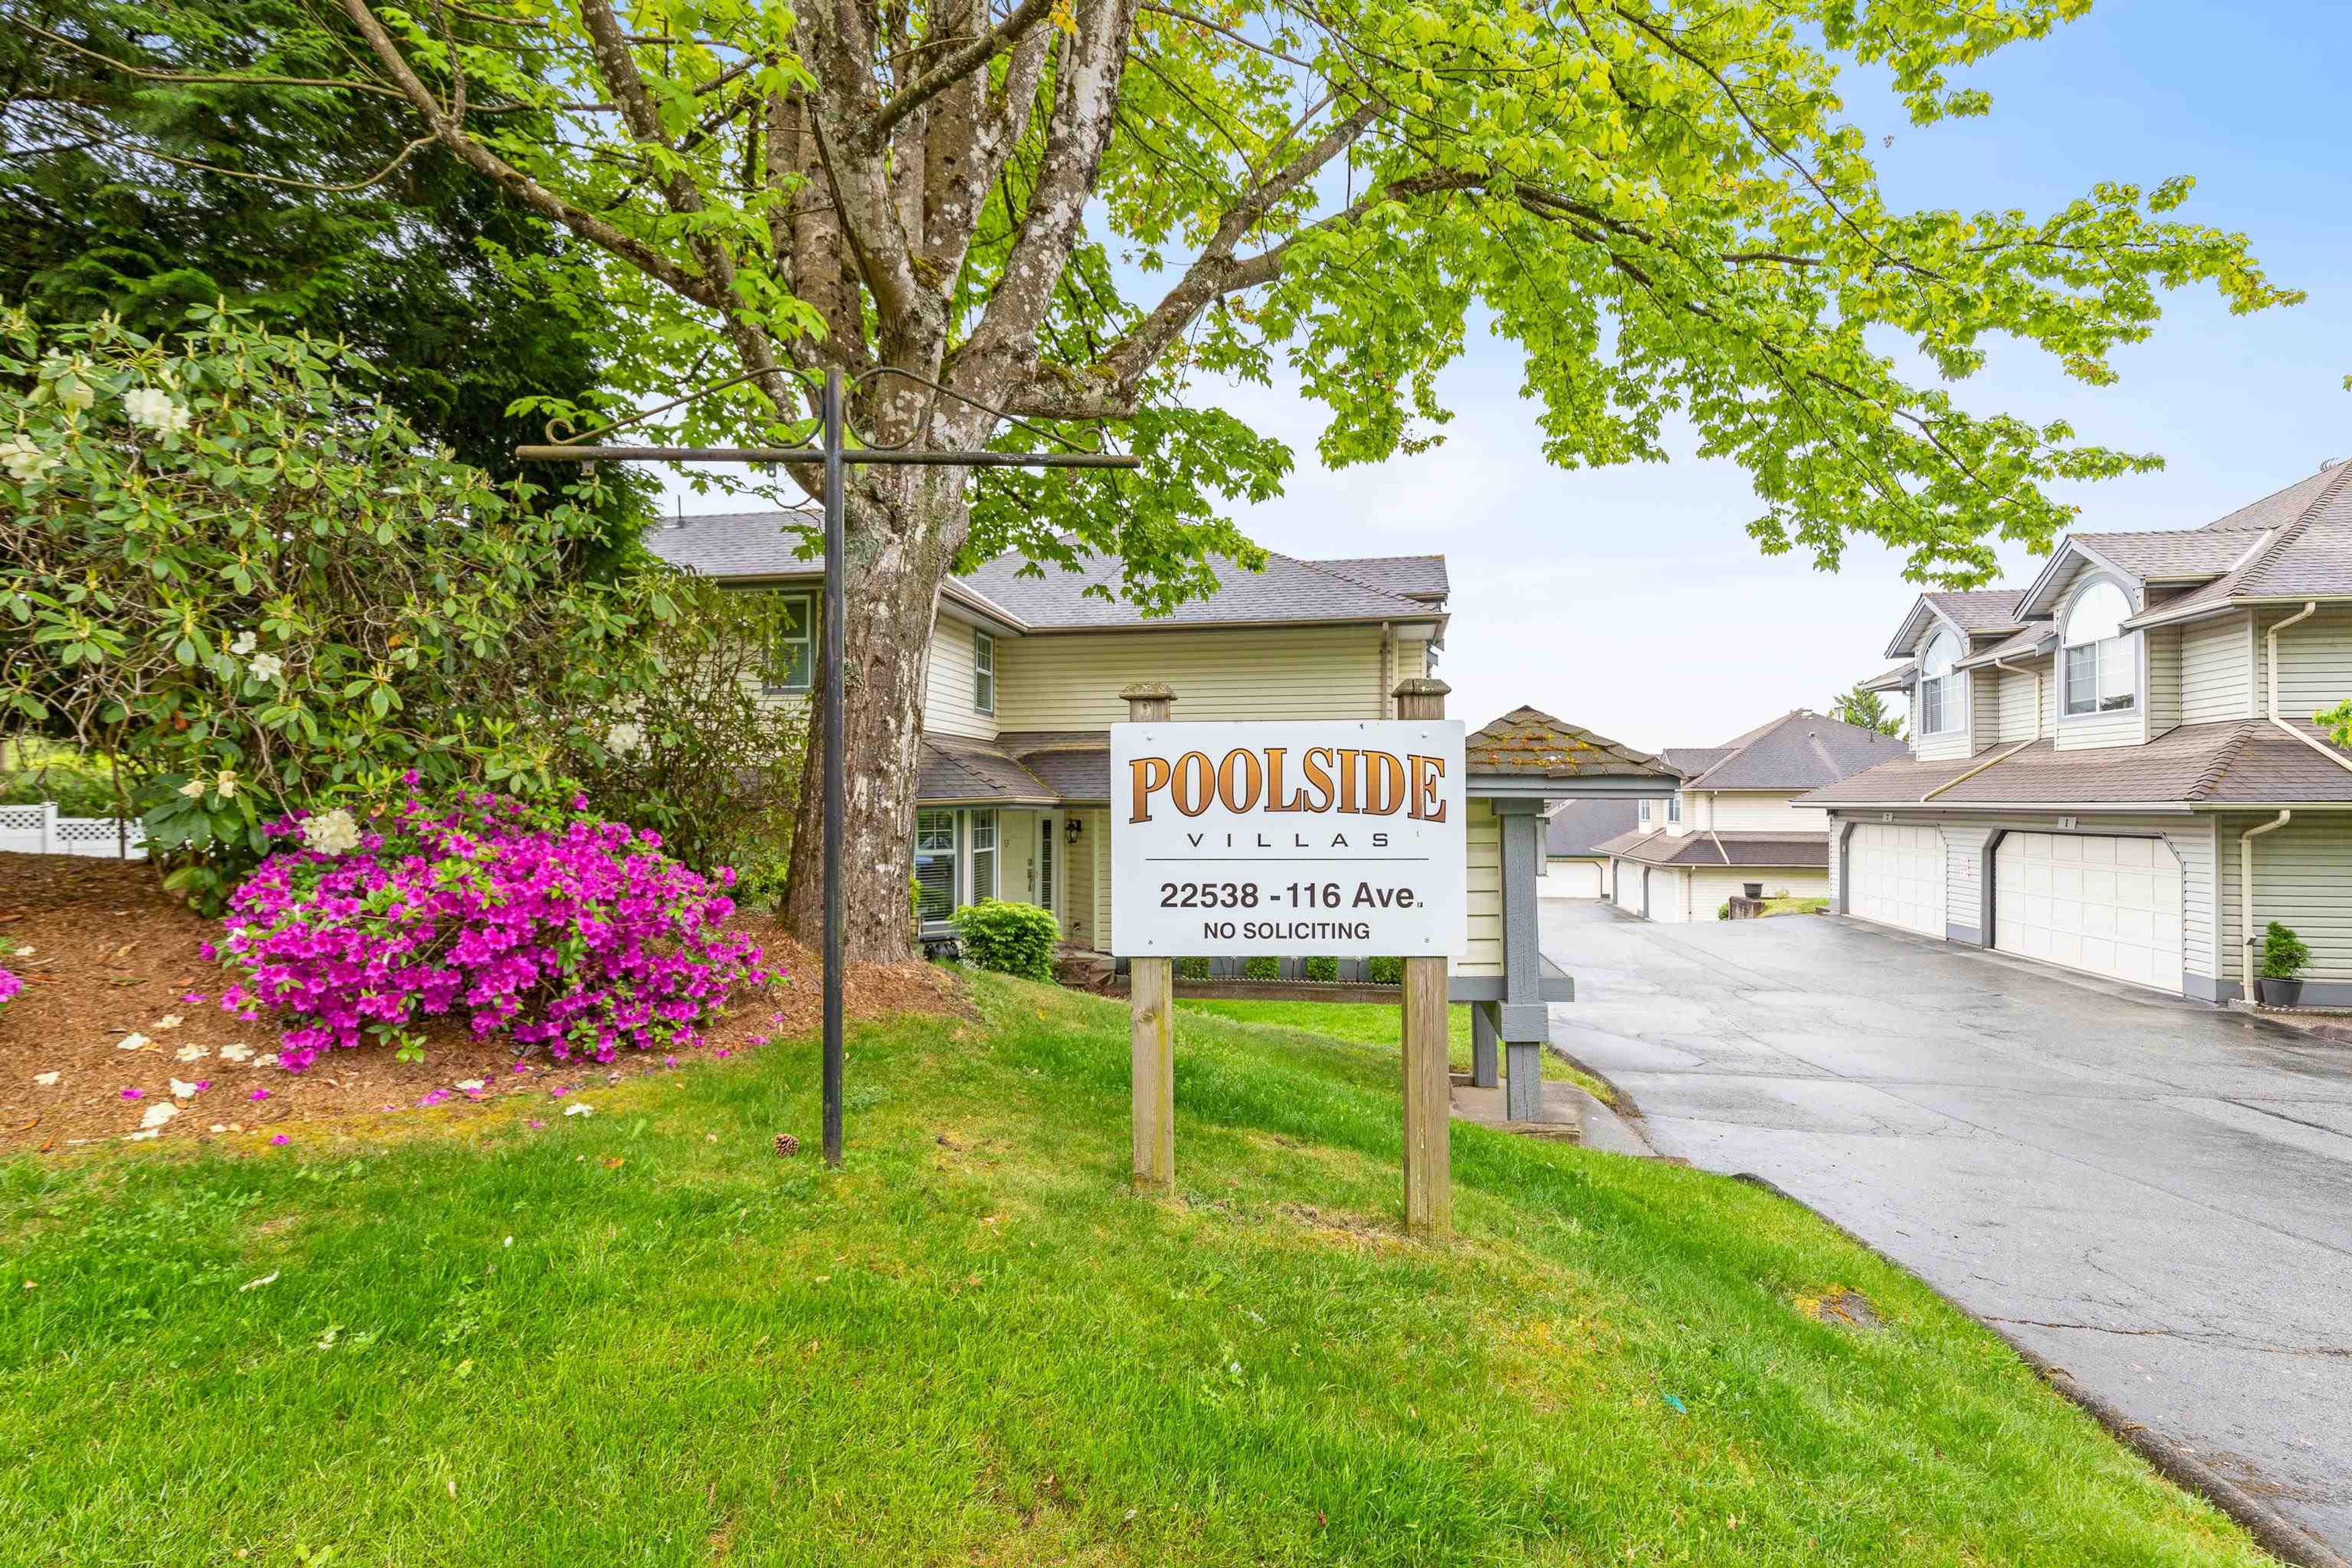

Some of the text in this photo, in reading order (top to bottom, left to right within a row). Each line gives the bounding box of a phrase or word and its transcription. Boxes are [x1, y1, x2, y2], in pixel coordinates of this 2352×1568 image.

[1128, 747, 1447, 824] POOLSIDE
[1186, 833, 1389, 848] VILLAS
[1160, 882, 1259, 908] 22538
[1352, 881, 1424, 908] Ave.
[1204, 922, 1370, 940] NO SOLICITING
